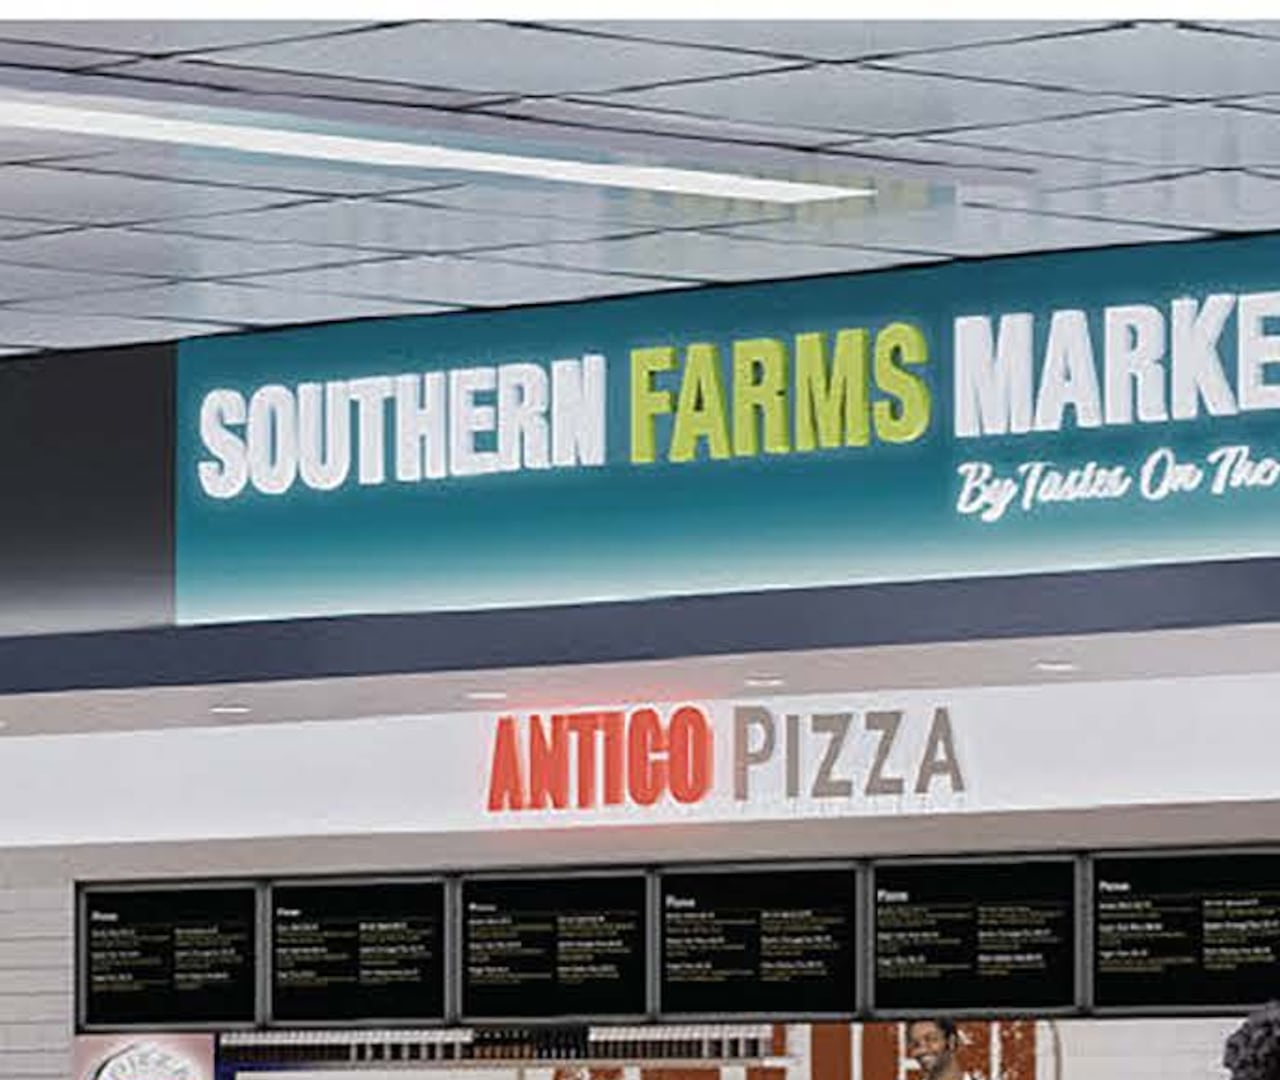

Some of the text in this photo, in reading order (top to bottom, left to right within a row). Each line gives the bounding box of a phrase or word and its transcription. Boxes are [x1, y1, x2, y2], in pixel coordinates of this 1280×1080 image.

[198, 354, 606, 500] SOUTHERN
[628, 321, 929, 464] FARMS
[956, 461, 1018, 522] By
[1139, 446, 1204, 500] On
[486, 703, 966, 813] ANTICO PIZZA
